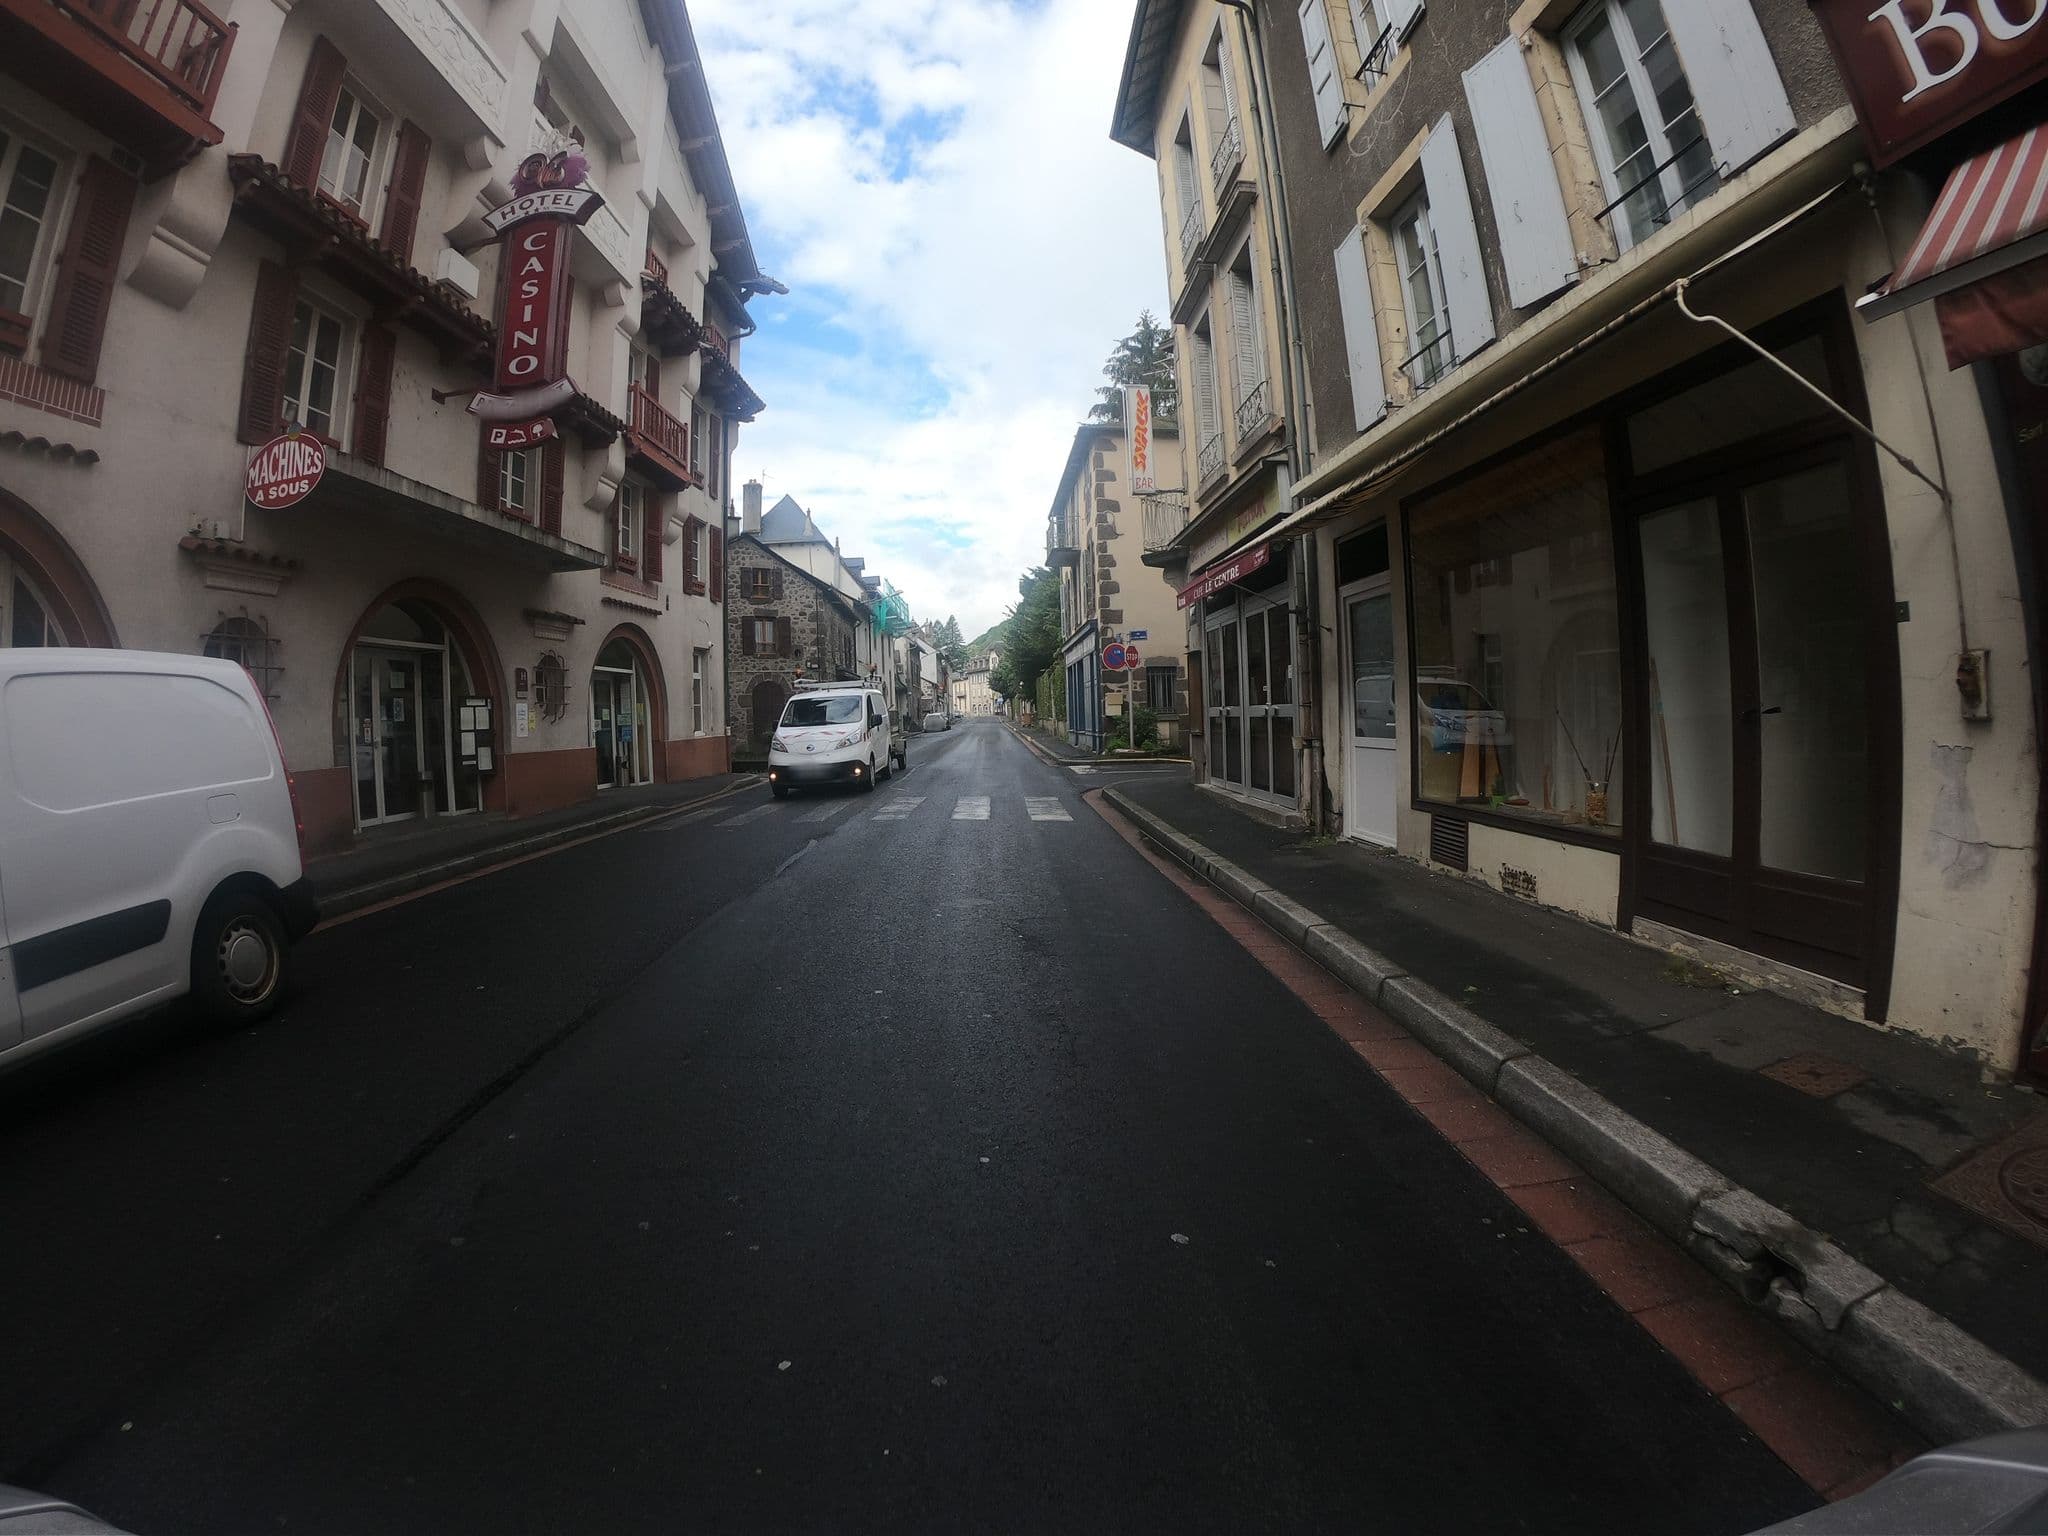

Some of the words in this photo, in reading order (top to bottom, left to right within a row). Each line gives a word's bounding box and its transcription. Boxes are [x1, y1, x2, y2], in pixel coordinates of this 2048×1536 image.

[500, 194, 575, 221] HOTEL
[508, 232, 548, 376] CASINO
[1133, 389, 1149, 472] SNACK
[248, 441, 322, 489] MACHINES
[255, 490, 264, 502] A
[269, 480, 309, 499] SOUS
[1135, 477, 1153, 490] BAR
[1205, 580, 1213, 593] LE
[1214, 565, 1239, 587] CENTRE
[1126, 653, 1138, 661] STOP
